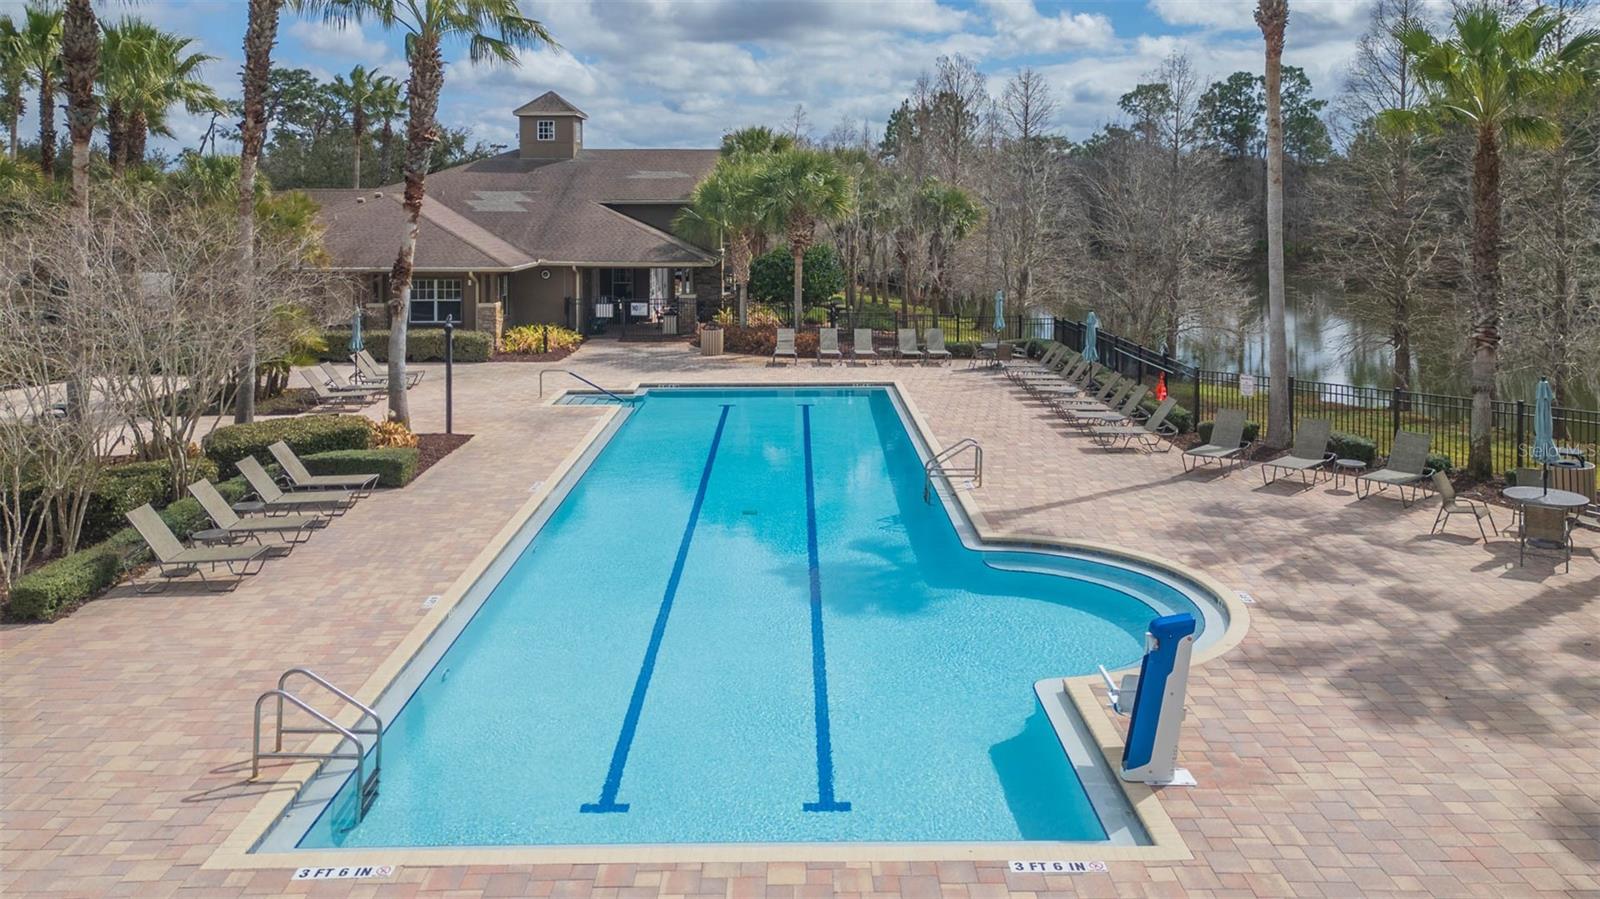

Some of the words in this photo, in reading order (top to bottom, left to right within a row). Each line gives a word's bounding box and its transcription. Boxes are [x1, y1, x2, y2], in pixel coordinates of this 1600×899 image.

[1014, 862, 1024, 871] 3
[1029, 862, 1046, 871] FT
[1053, 862, 1063, 871] 6
[1069, 862, 1086, 871] IN
[298, 868, 310, 878] 3
[313, 868, 335, 878] FT
[339, 867, 350, 877] 6
[354, 867, 373, 877] IN
